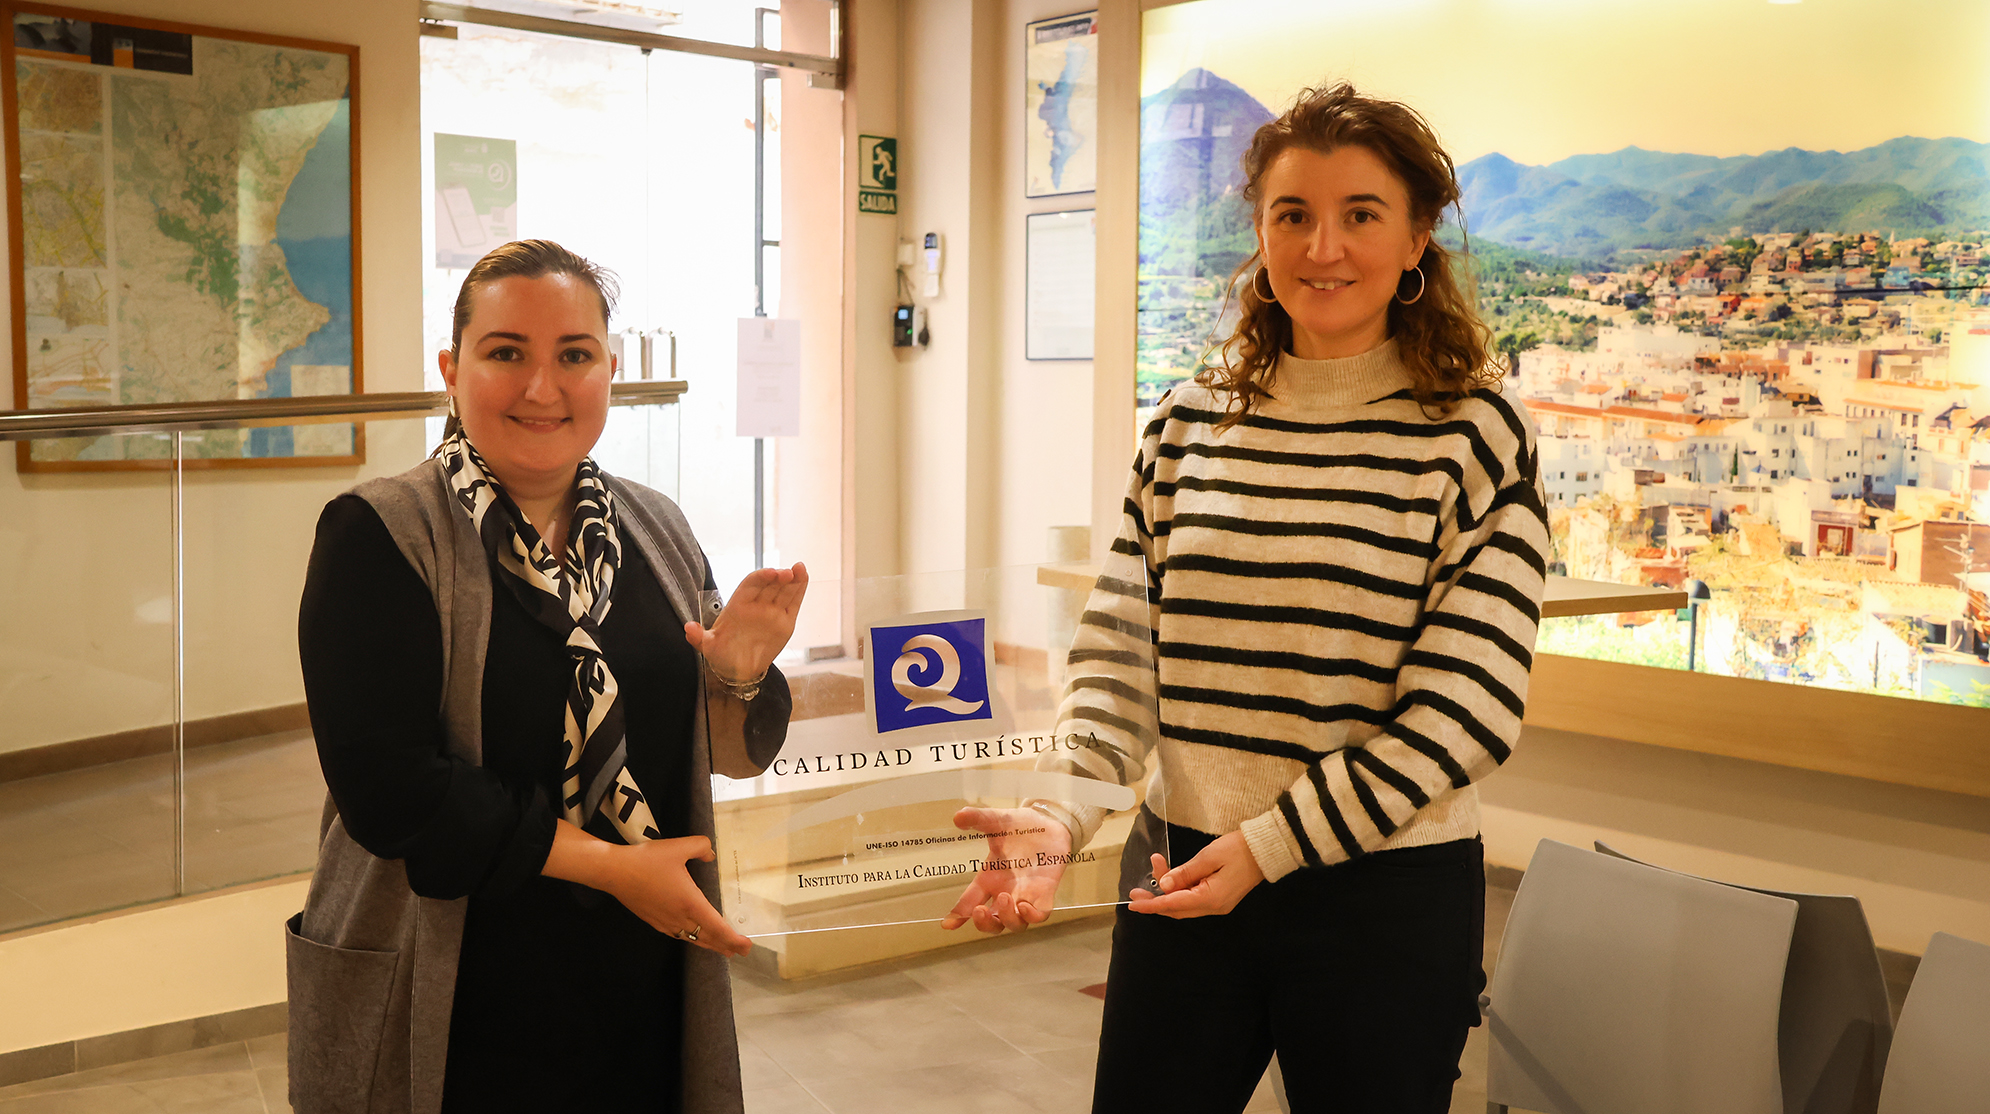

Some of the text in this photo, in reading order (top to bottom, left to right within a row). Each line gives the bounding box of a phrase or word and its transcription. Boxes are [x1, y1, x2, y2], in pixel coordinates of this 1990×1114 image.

[860, 194, 896, 211] SALIDA
[773, 731, 1101, 776] CALIDAD TURÍSTICA
[866, 840, 899, 850] UNE-ISO
[901, 838, 924, 847] 14785
[925, 835, 956, 845] Oficinas
[957, 834, 967, 842] de
[968, 830, 1013, 841] Información
[798, 850, 1096, 888] INSTITUTO PARA LA CALIDAD TURÍSTICA ESPAÑOLA
